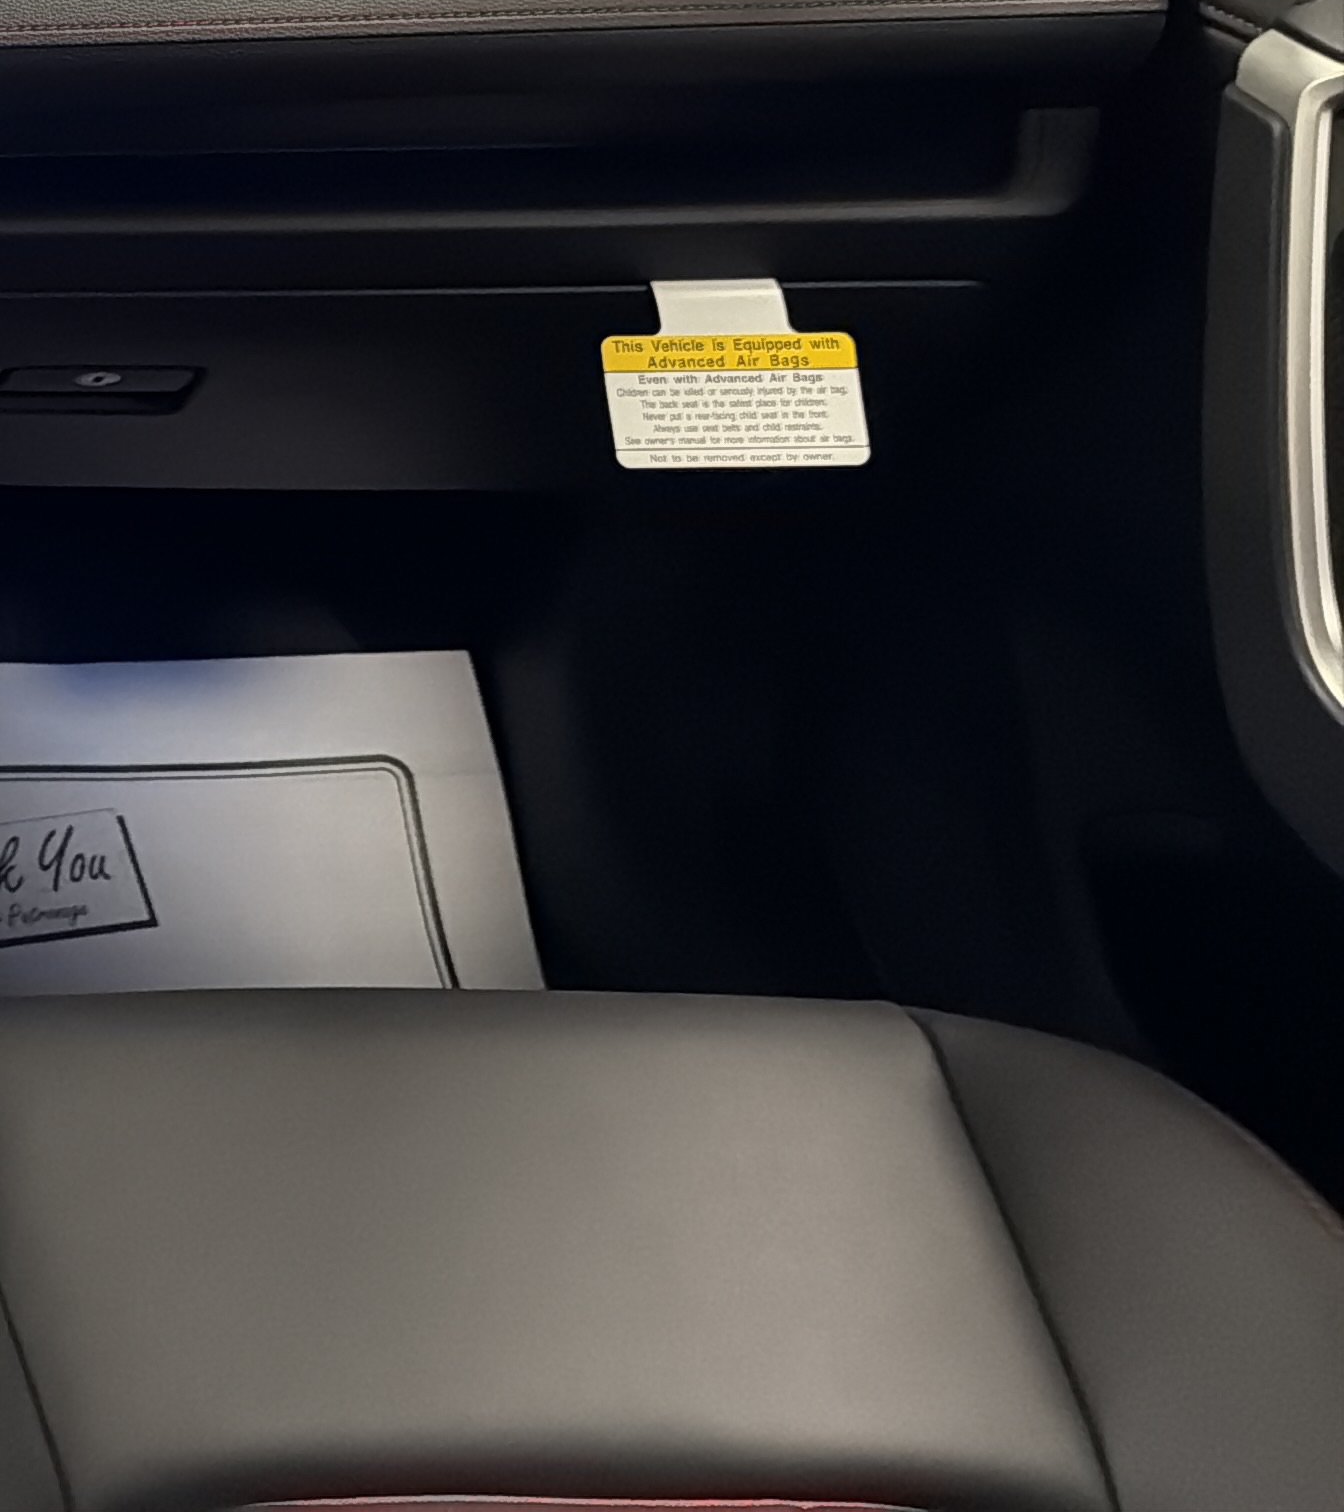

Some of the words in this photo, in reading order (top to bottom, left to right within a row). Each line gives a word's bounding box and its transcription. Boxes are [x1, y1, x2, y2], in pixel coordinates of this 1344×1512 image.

[612, 340, 644, 353] This
[651, 339, 704, 352] Vehicle
[732, 338, 802, 353] Equipped
[809, 337, 840, 350] with
[647, 355, 725, 369] Advanced
[736, 355, 760, 367] Air
[769, 353, 810, 368] Bags
[638, 375, 667, 385] Even
[673, 374, 698, 384] with
[705, 373, 763, 384] Advanced
[769, 373, 788, 383] Air
[793, 372, 824, 384] Bags
[616, 388, 649, 397] Children
[650, 454, 667, 462] Not
[671, 454, 682, 462] to
[686, 454, 698, 462] be
[703, 454, 745, 462] removed
[750, 453, 781, 463] except
[786, 453, 798, 462] by
[37, 824, 112, 892] You
